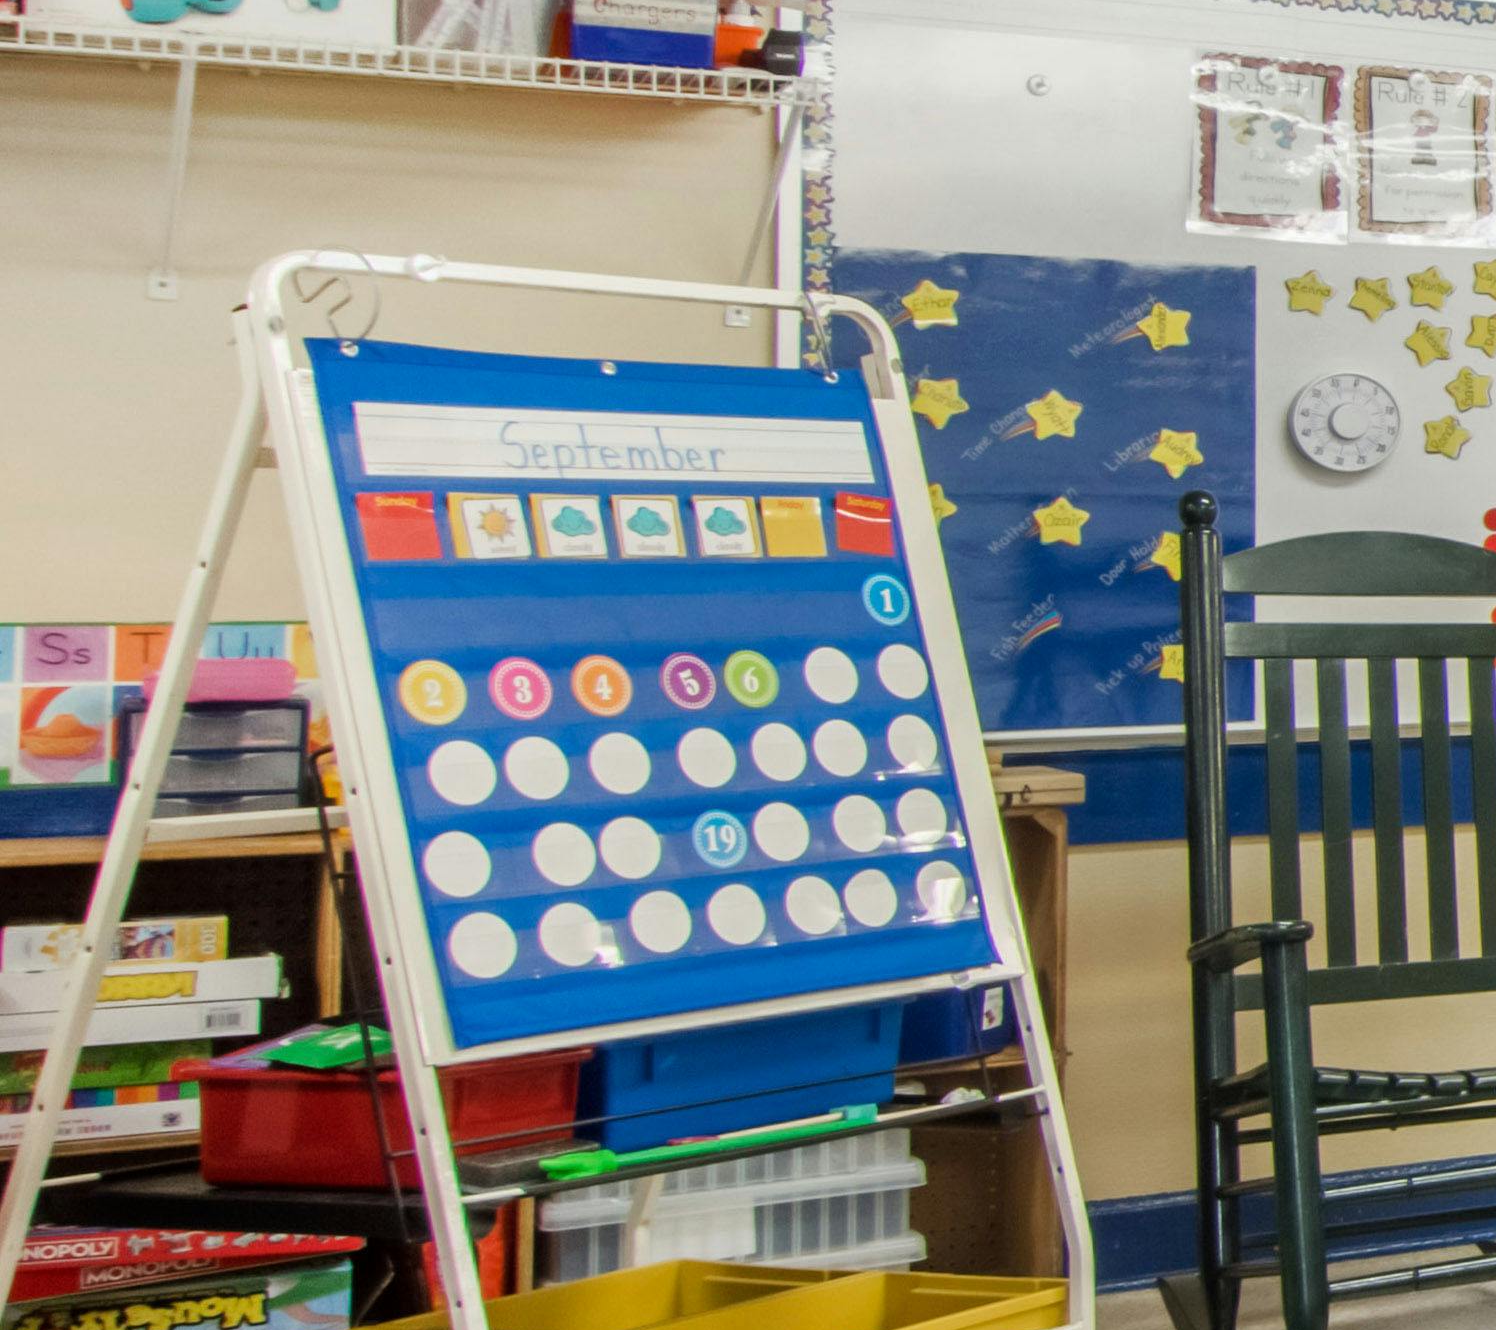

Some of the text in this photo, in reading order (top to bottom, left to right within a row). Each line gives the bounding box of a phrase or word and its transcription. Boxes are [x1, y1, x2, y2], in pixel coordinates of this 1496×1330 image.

[1377, 80, 1425, 106] Rule
[500, 420, 726, 480] September
[960, 434, 993, 462] Time
[1104, 430, 1161, 471] Libraria
[374, 495, 419, 510] Sunday
[1098, 529, 1161, 588] Door Hold
[880, 587, 895, 615] 1
[989, 592, 1056, 663] Fish Feeder
[37, 632, 92, 665] Ss
[420, 678, 443, 708] 2
[512, 675, 532, 705] 3
[592, 673, 613, 701] 4
[678, 670, 701, 696] 5
[742, 665, 760, 694] 6
[1095, 664, 1127, 697] Pick
[702, 823, 739, 853] 19
[22, 1241, 114, 1260] NOPOLY
